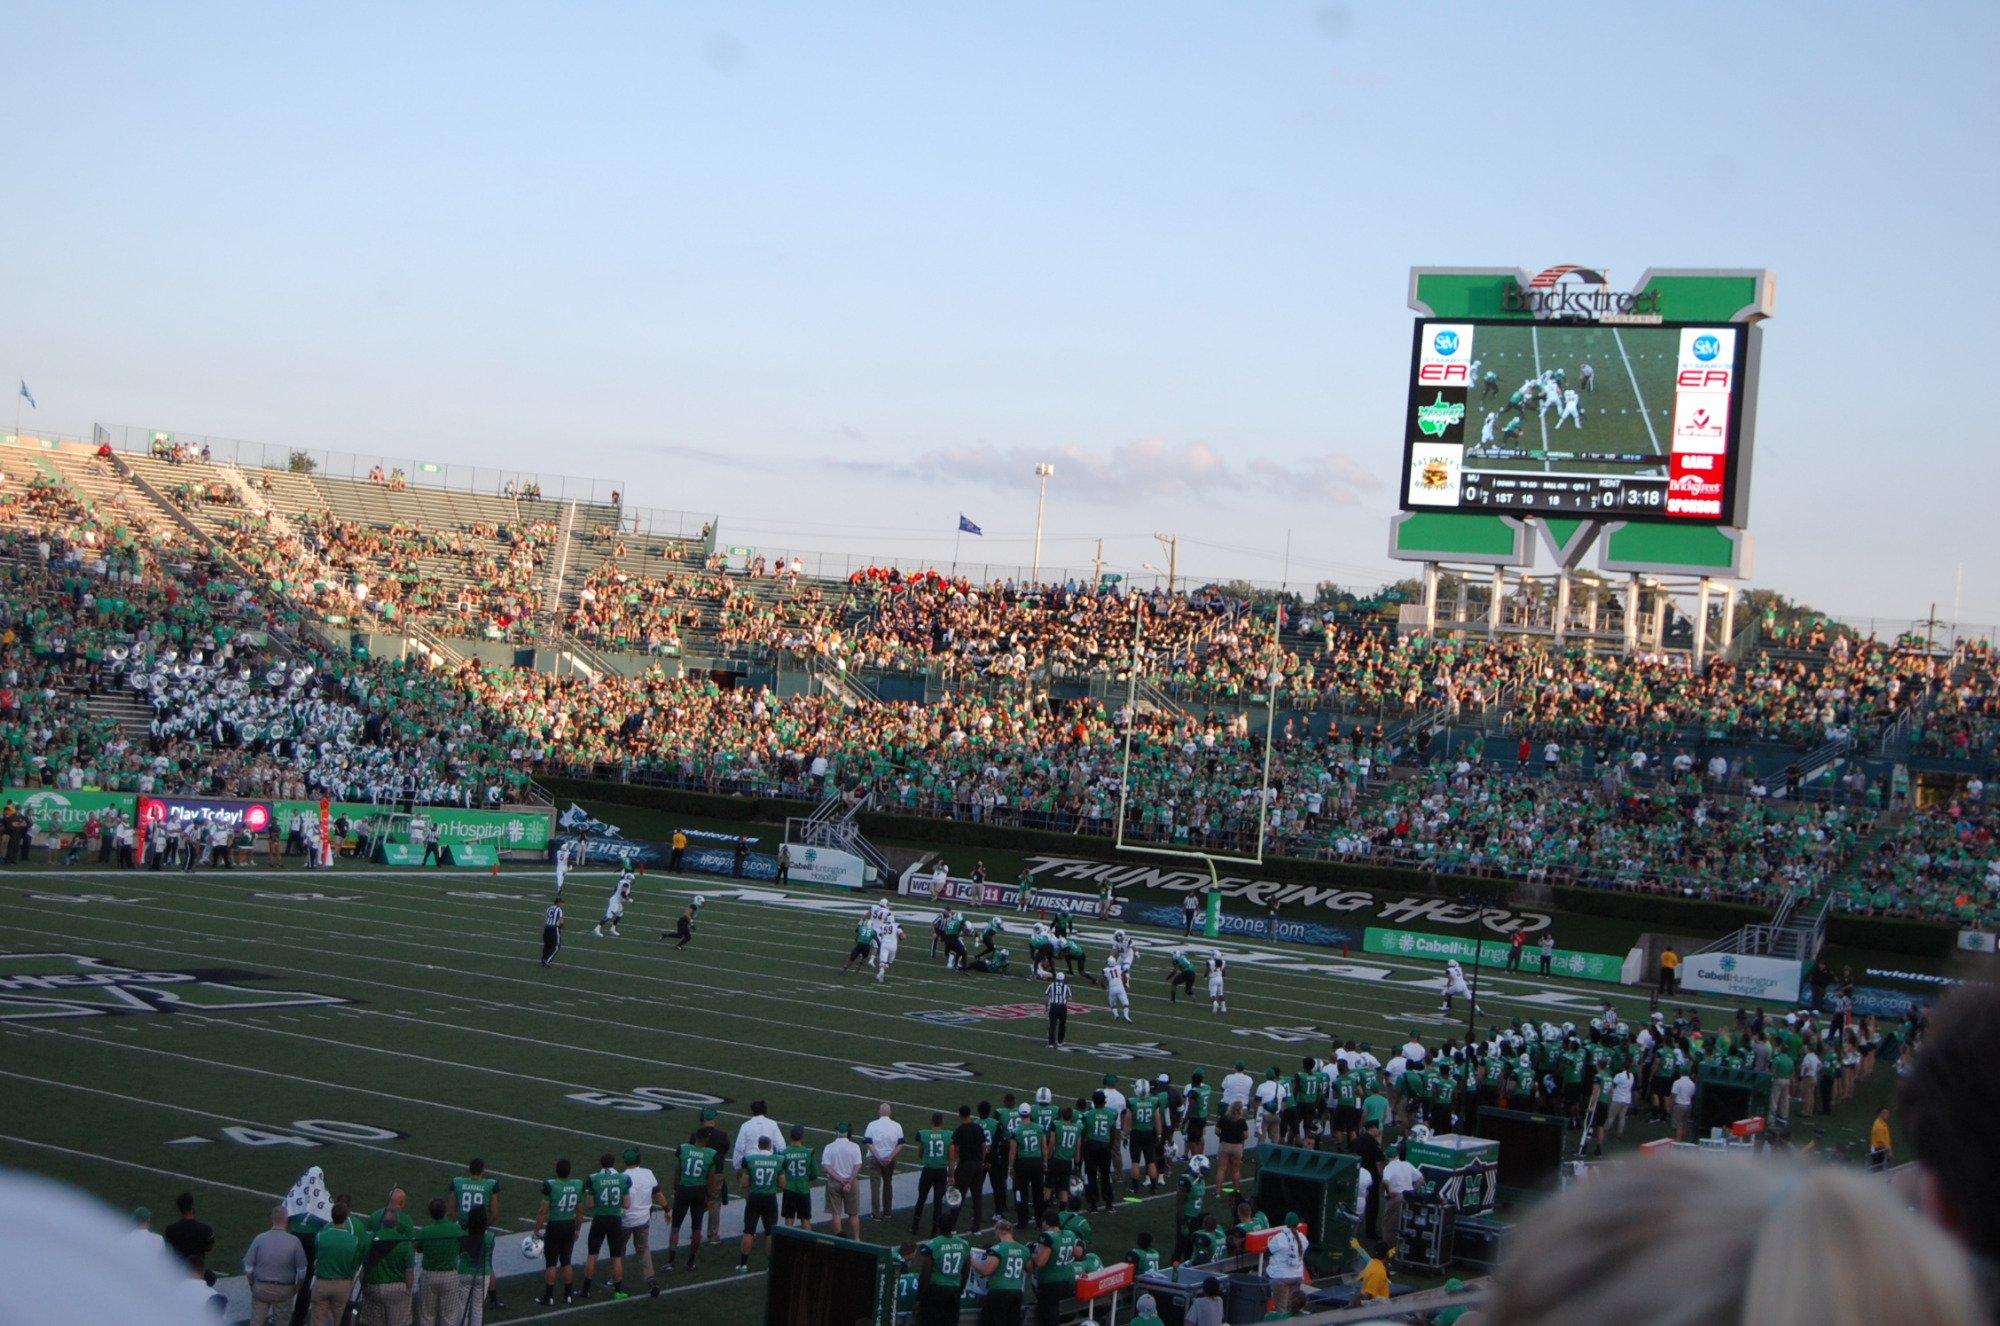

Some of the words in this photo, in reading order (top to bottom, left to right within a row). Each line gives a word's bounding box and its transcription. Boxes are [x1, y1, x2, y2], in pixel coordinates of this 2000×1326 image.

[1420, 364, 1467, 381] ER
[1678, 370, 1728, 388] ER
[1599, 479, 1621, 488] KENT
[1466, 486, 1476, 501] 0
[1495, 492, 1514, 503] 1ST
[1522, 494, 1534, 505] 10
[1603, 491, 1614, 507] 0
[1627, 489, 1660, 506] 3:18
[450, 821, 505, 838] Hospital
[1023, 856, 1373, 911] THUNDERING
[1377, 897, 1551, 933] HERD
[1231, 1026, 1332, 1042] 20
[1057, 1042, 1173, 1060] 30
[850, 1061, 975, 1082] 40
[565, 1087, 731, 1112] 50
[1136, 1108, 1152, 1123] 82
[218, 1119, 400, 1147] 40
[1093, 1120, 1108, 1136] 15
[929, 1140, 945, 1157] 13
[1023, 1136, 1038, 1151] 12
[1061, 1132, 1076, 1149] 10
[684, 1158, 704, 1177] 16
[788, 1159, 807, 1176] 45
[755, 1168, 775, 1186] 97
[600, 1186, 620, 1206] 43
[941, 1252, 962, 1275] 67
[1003, 1257, 1023, 1279] 58
